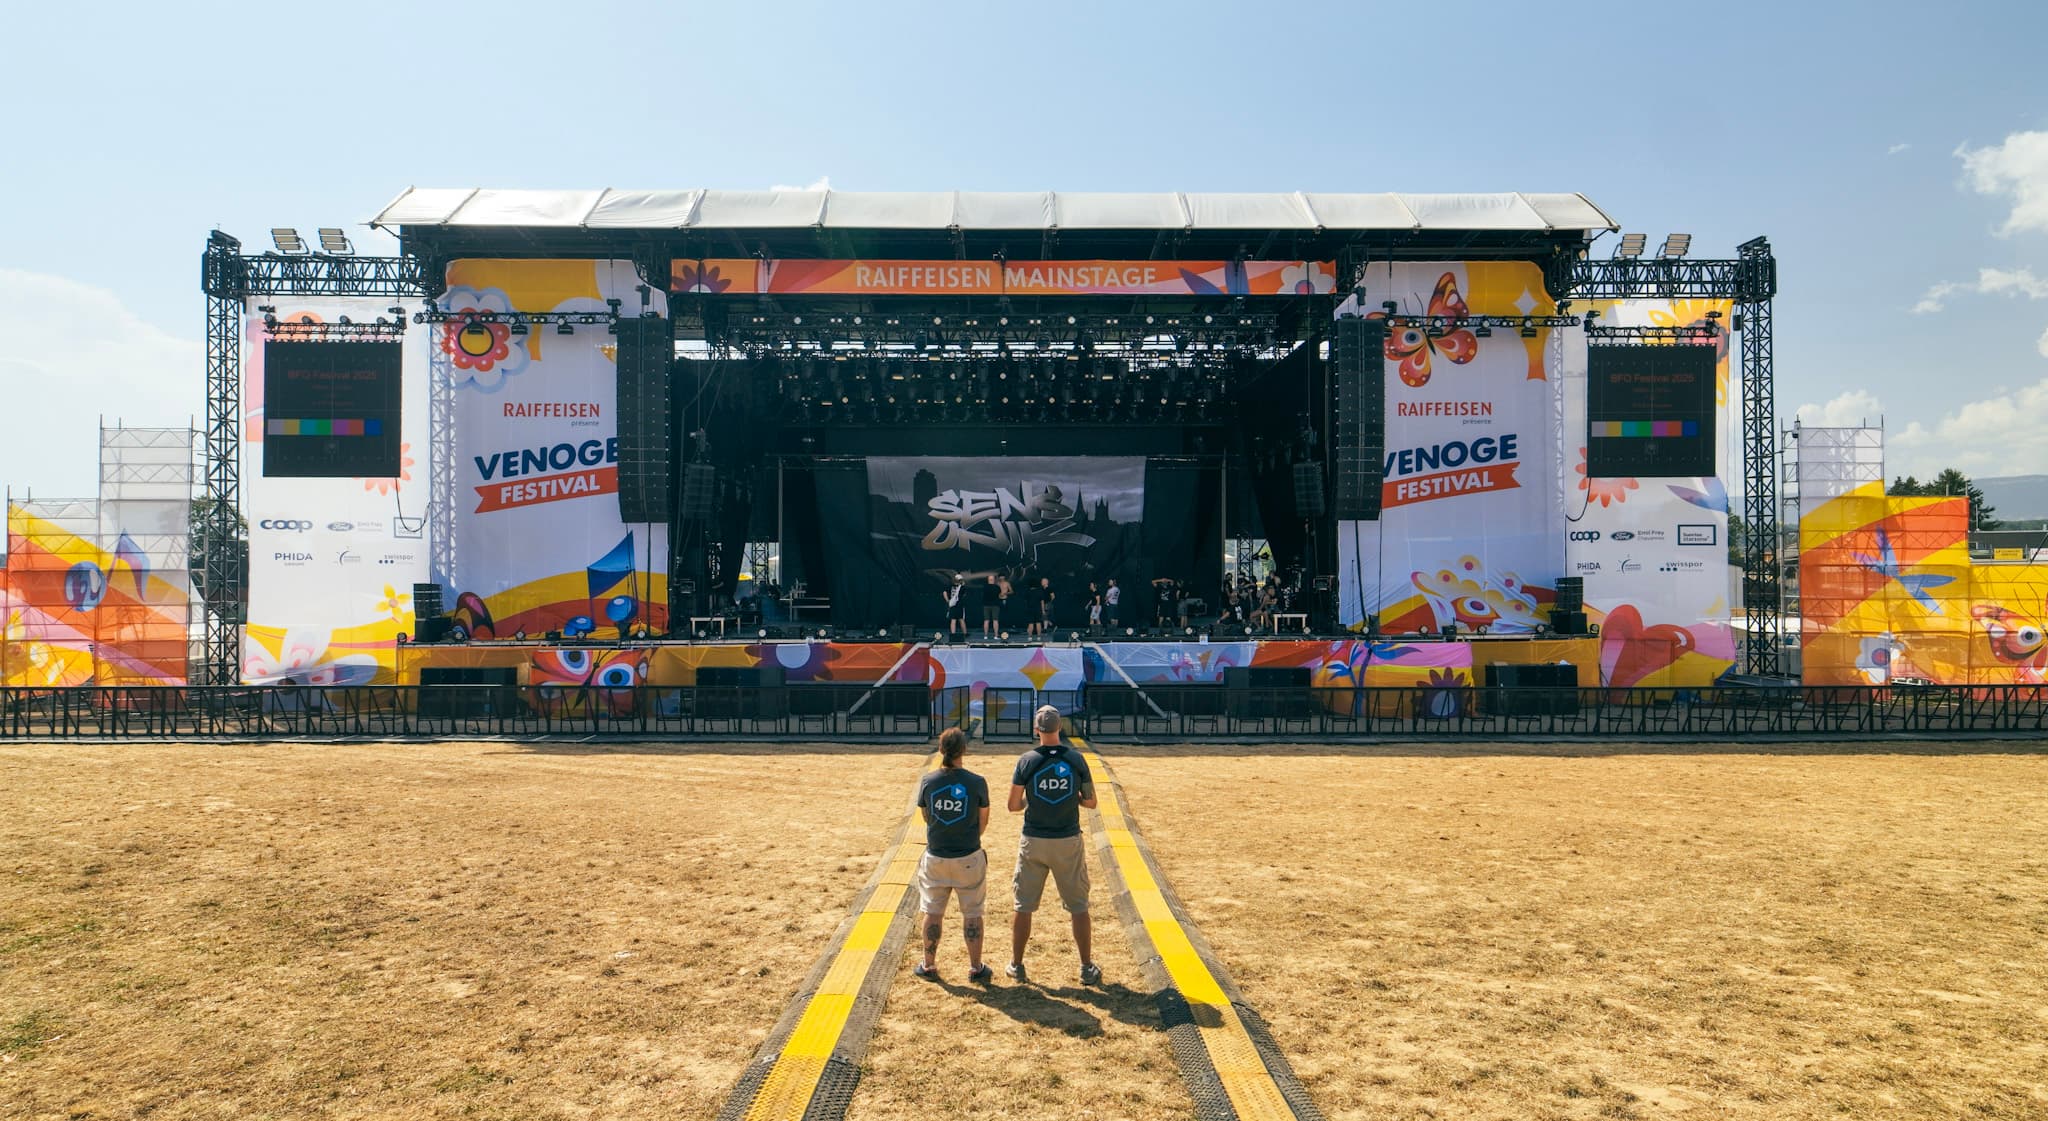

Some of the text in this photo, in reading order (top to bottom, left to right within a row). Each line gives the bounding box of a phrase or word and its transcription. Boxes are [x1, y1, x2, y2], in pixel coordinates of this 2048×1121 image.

[855, 266, 1157, 288] RAIFFEISEN MAINSTAGE
[503, 402, 600, 418] RAIFFEISEN
[1397, 401, 1492, 417] RAIFFEISEN
[500, 473, 601, 505] FESTIVAL
[1396, 470, 1495, 502] FESTIVAL
[260, 518, 314, 534] coop
[1569, 530, 1601, 543] coop
[274, 552, 313, 561] PHIDA
[1577, 562, 1601, 570] PHIDA
[1666, 560, 1704, 569] swisspor
[1038, 777, 1069, 791] 4D2
[934, 798, 963, 812] 4D2
